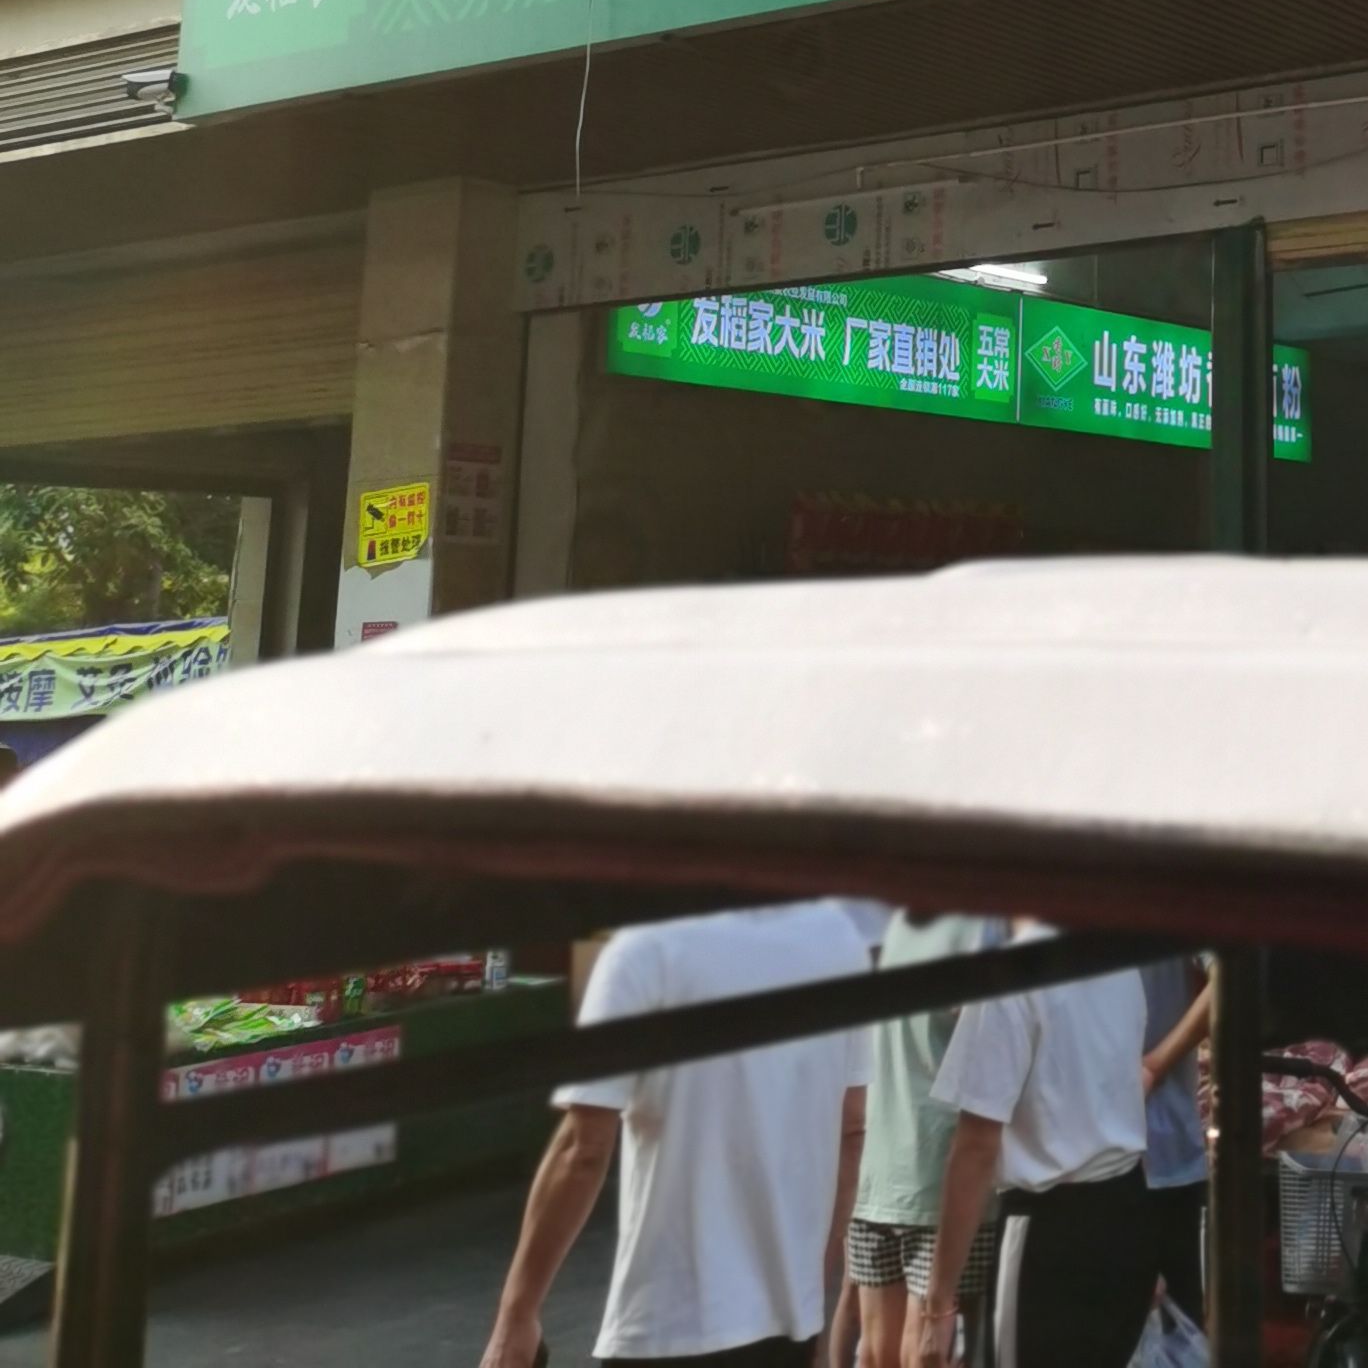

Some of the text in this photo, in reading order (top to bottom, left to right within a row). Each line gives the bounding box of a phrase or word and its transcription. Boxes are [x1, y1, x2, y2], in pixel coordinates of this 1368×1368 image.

[691, 296, 961, 381] 发稻家大米 厂家直销处
[977, 325, 1010, 358] 五常
[976, 358, 1010, 391] 大米
